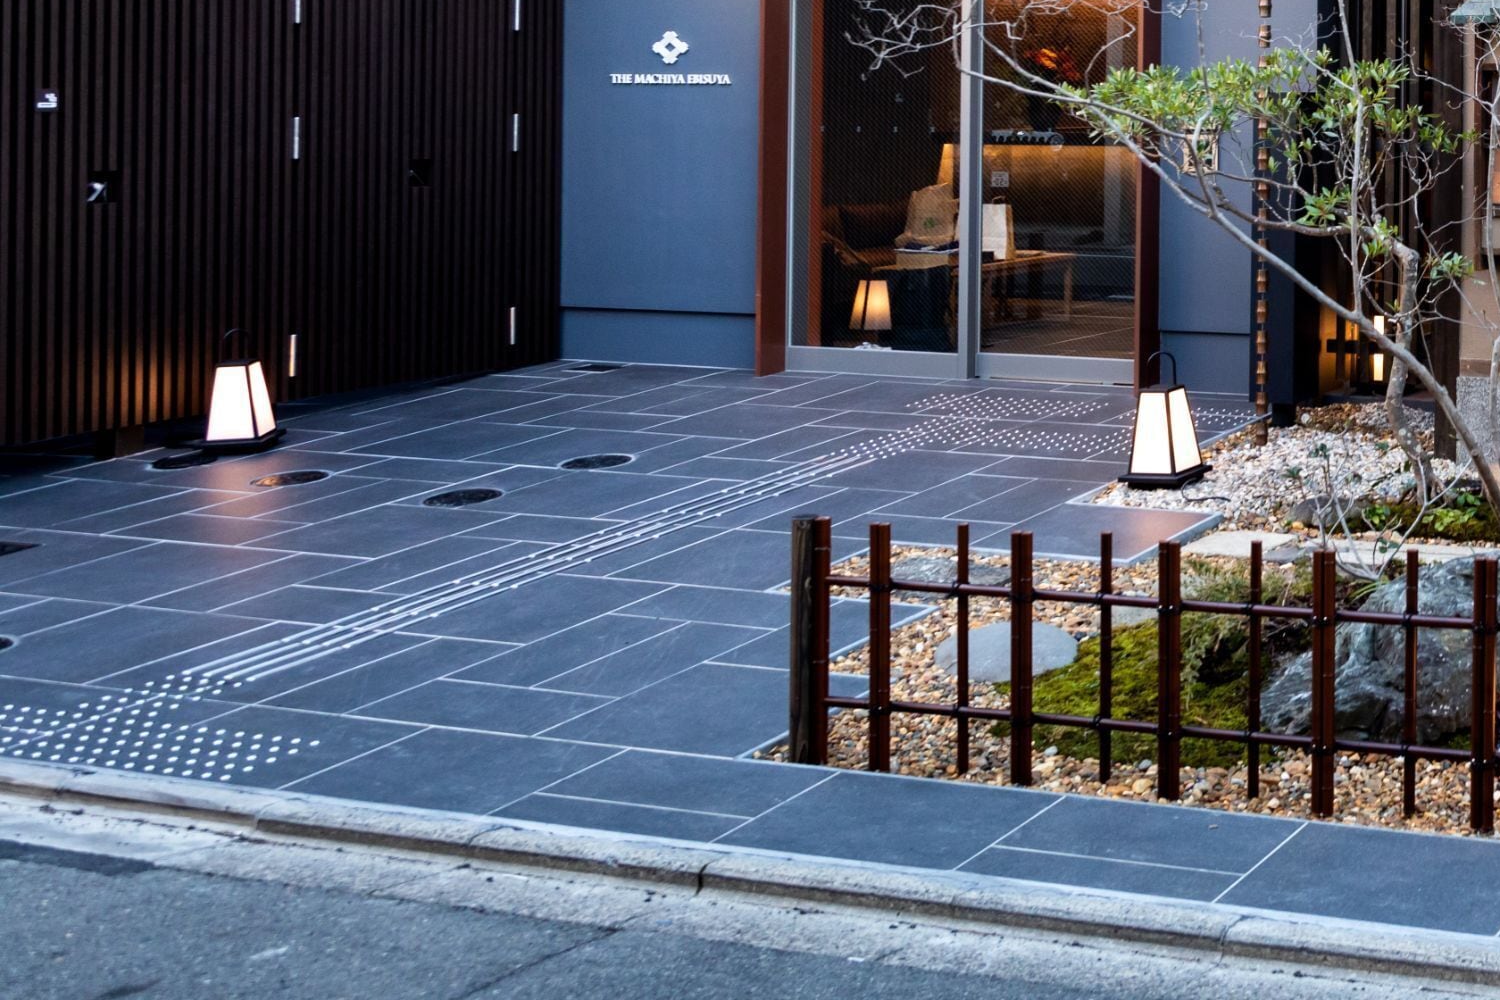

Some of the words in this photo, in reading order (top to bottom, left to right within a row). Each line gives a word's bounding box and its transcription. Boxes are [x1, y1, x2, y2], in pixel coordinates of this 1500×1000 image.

[610, 73, 632, 84] THE
[634, 73, 685, 85] MACHIYA
[687, 74, 731, 85] EBISUYA
